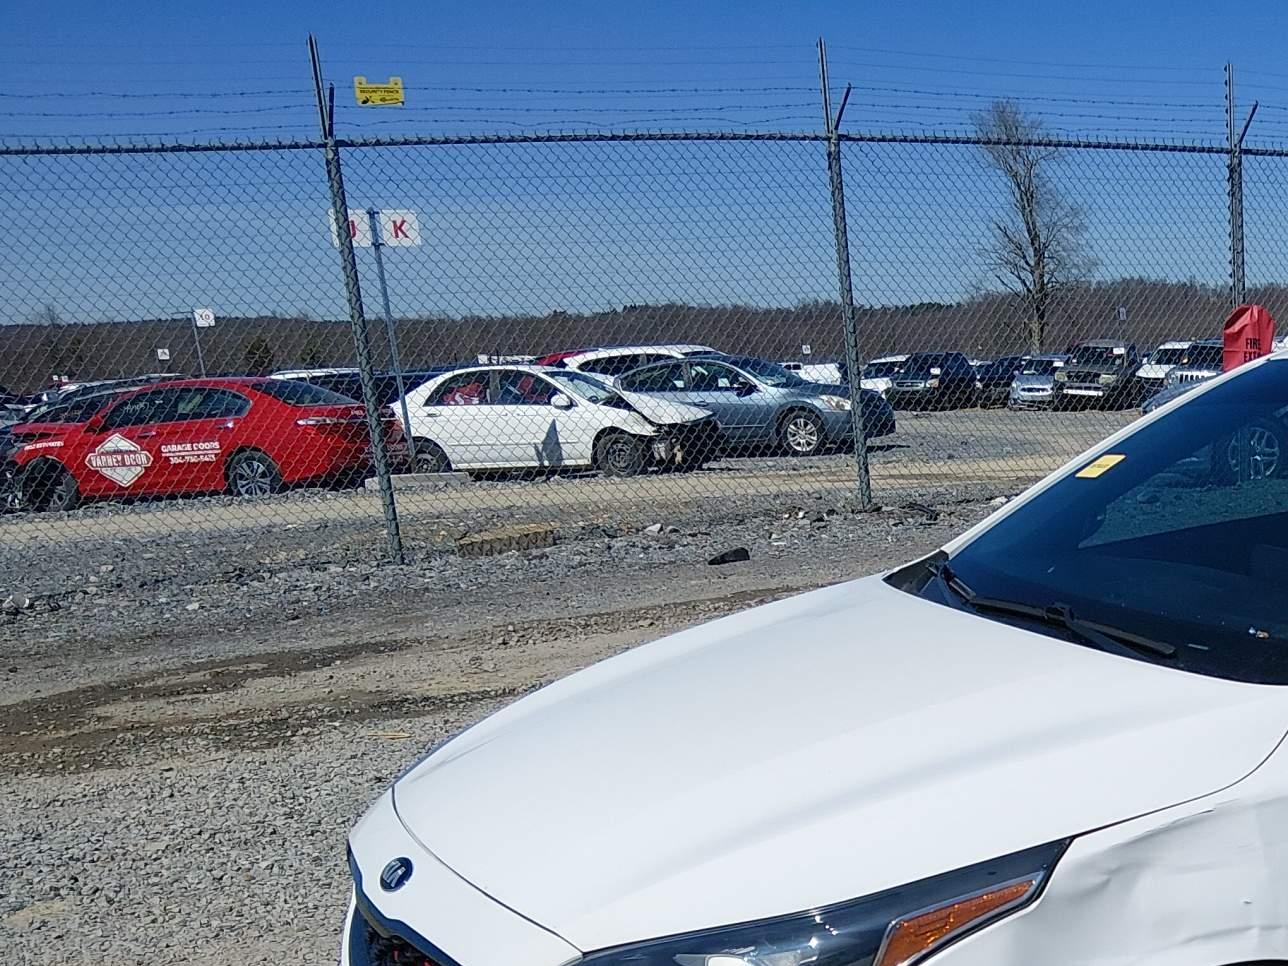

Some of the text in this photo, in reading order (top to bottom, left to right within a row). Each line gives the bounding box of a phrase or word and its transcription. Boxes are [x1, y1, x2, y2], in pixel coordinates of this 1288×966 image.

[392, 219, 410, 239] K
[1245, 338, 1262, 350] FIRE
[161, 443, 192, 453] GARAGE
